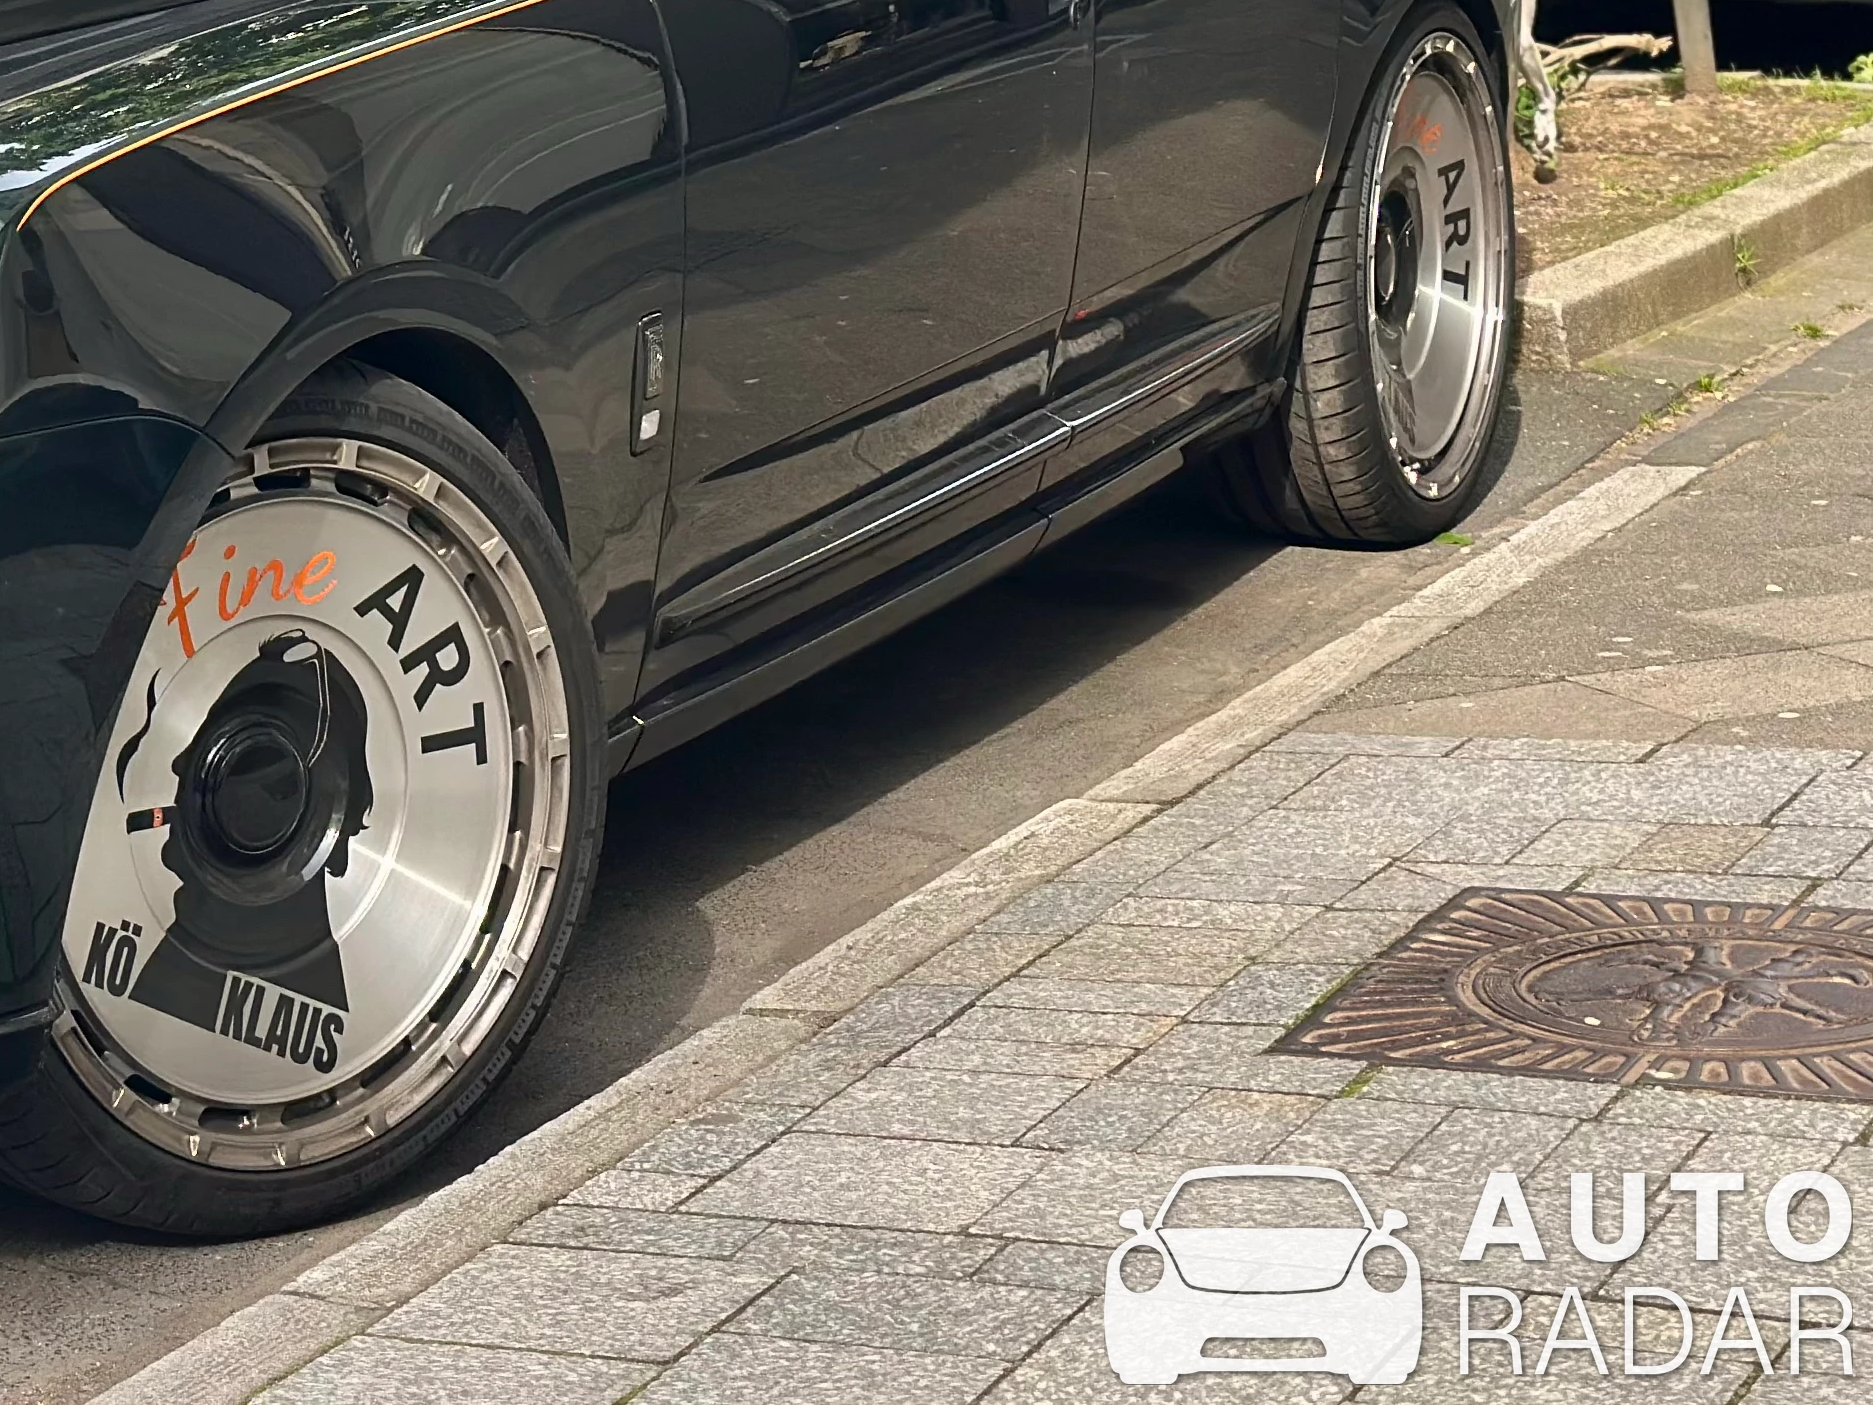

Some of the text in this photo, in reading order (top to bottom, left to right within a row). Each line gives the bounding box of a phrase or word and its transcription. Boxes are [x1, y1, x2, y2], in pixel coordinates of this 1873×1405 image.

[1437, 158, 1471, 302] ART
[353, 563, 488, 766] ART
[81, 919, 345, 1074] KÖ KLAUS
